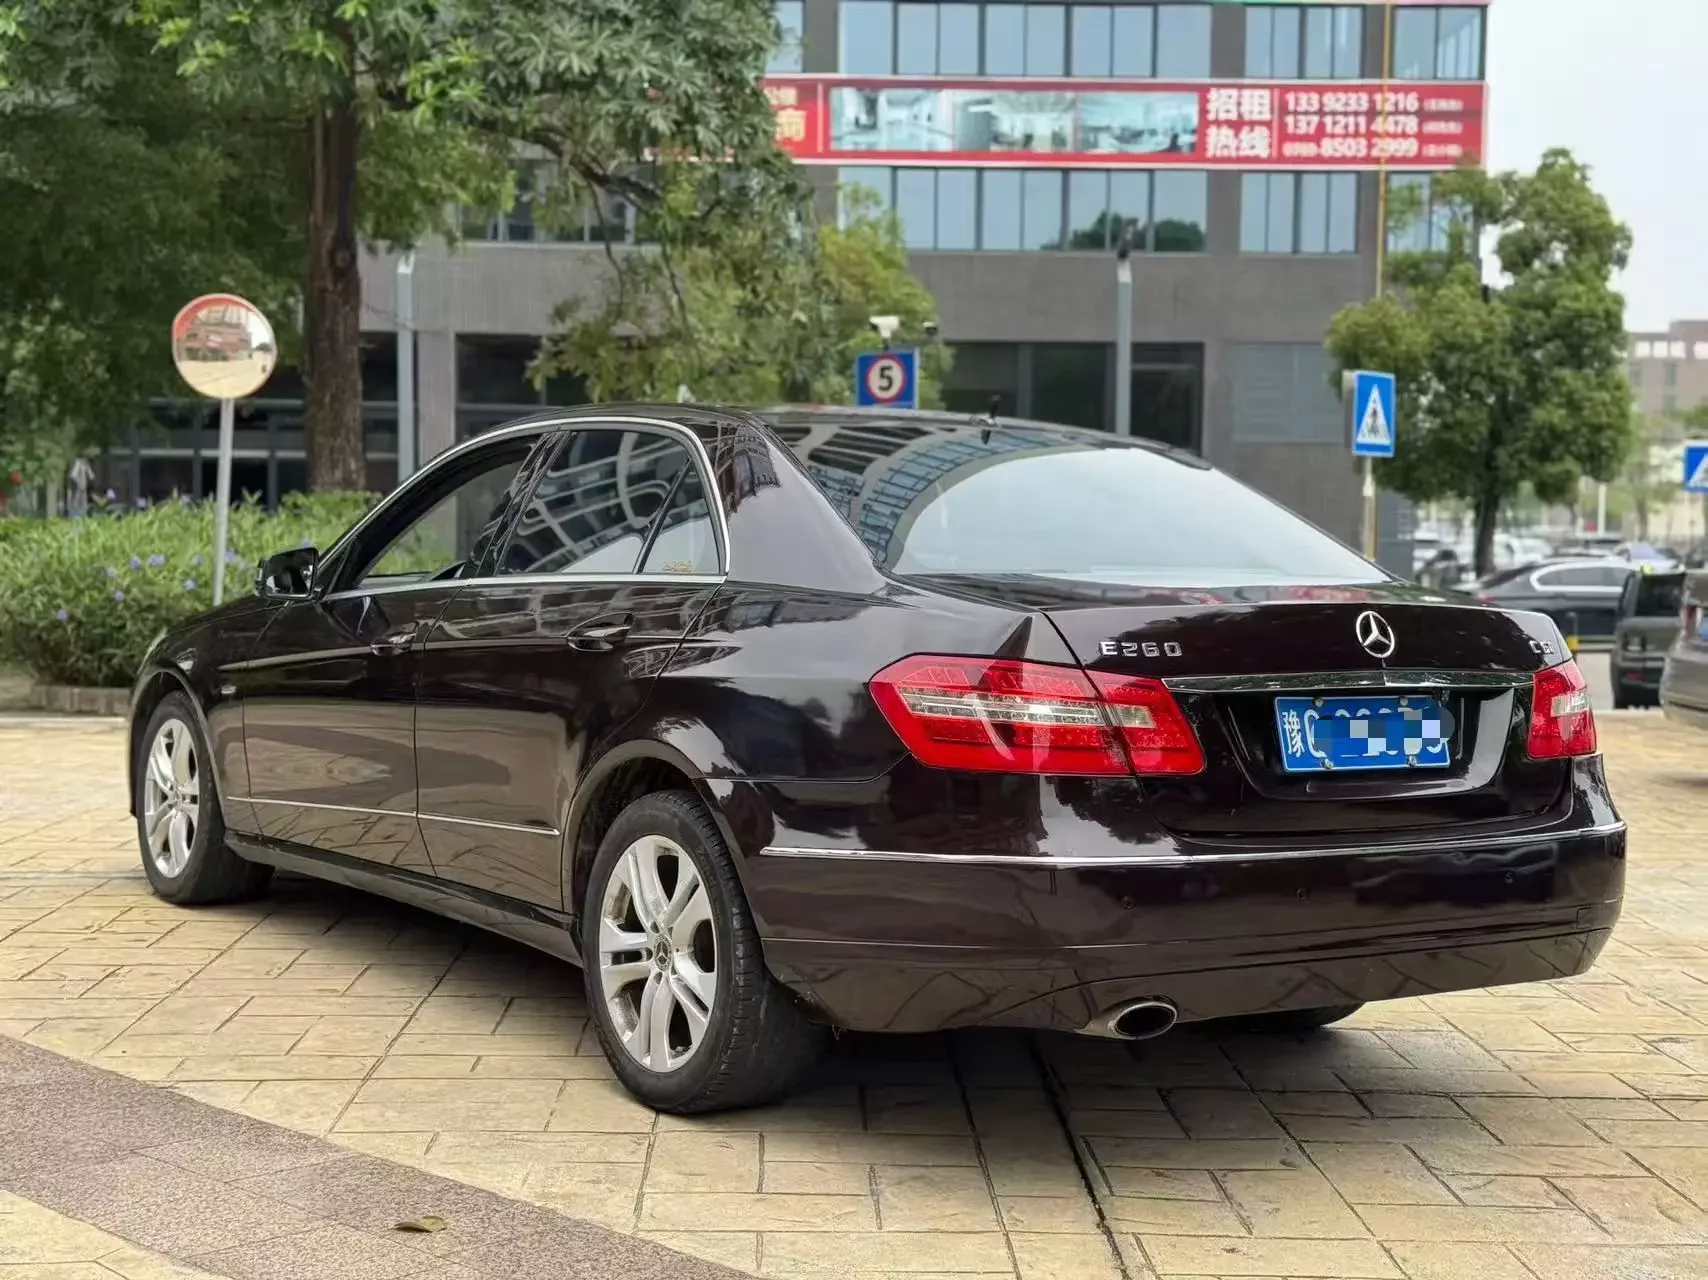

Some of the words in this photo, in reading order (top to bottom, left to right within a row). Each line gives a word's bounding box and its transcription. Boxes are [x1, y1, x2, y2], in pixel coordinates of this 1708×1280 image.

[1206, 87, 1271, 121] 招租
[1284, 91, 1320, 112] 133
[1322, 91, 1369, 112] 9233
[1372, 91, 1419, 112] 1216
[1284, 114, 1320, 135] 137
[1322, 114, 1366, 135] 1211
[1370, 114, 1419, 135] 4478
[1204, 124, 1271, 158] 热线
[878, 365, 894, 392] 5
[1100, 641, 1182, 657] E260
